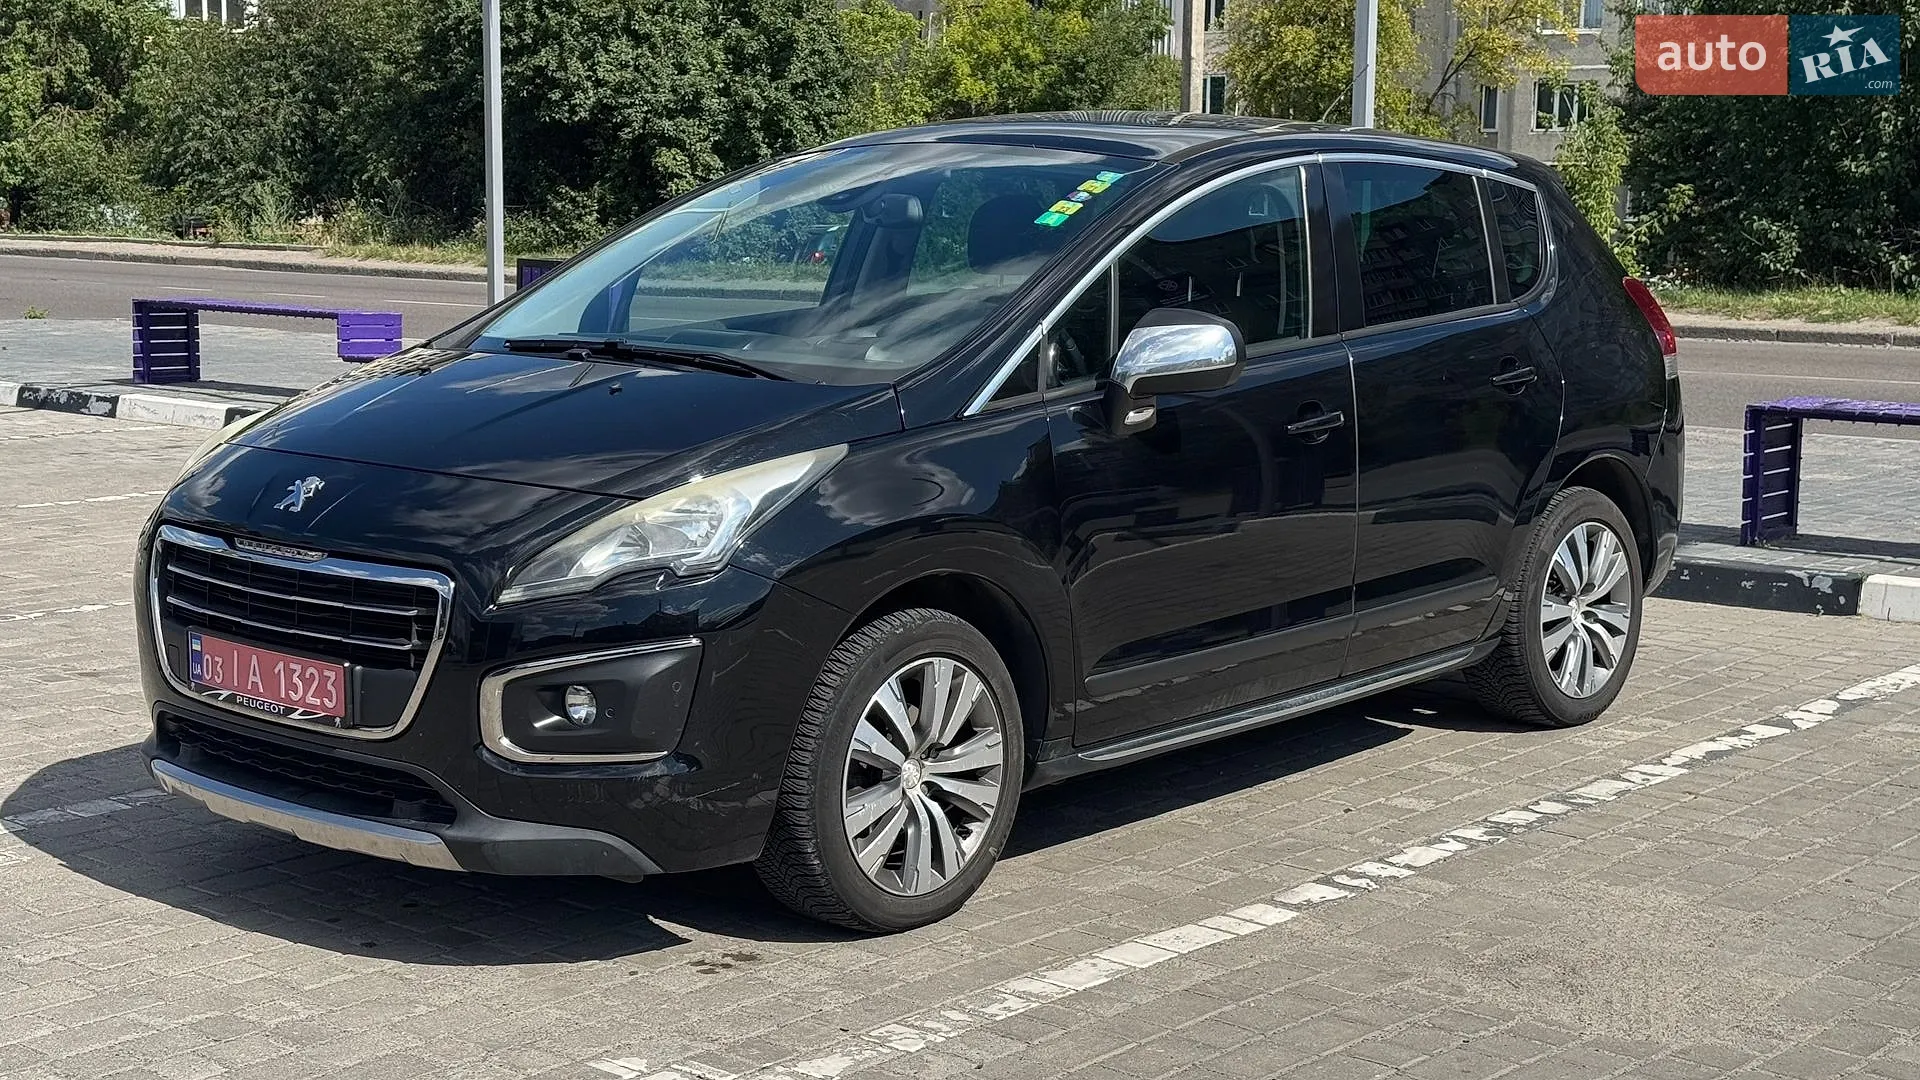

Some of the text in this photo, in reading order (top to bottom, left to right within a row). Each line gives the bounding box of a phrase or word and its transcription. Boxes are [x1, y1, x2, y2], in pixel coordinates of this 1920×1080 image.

[192, 663, 202, 676] UA
[274, 660, 337, 709] 1323
[236, 695, 286, 715] PEUGEOT
